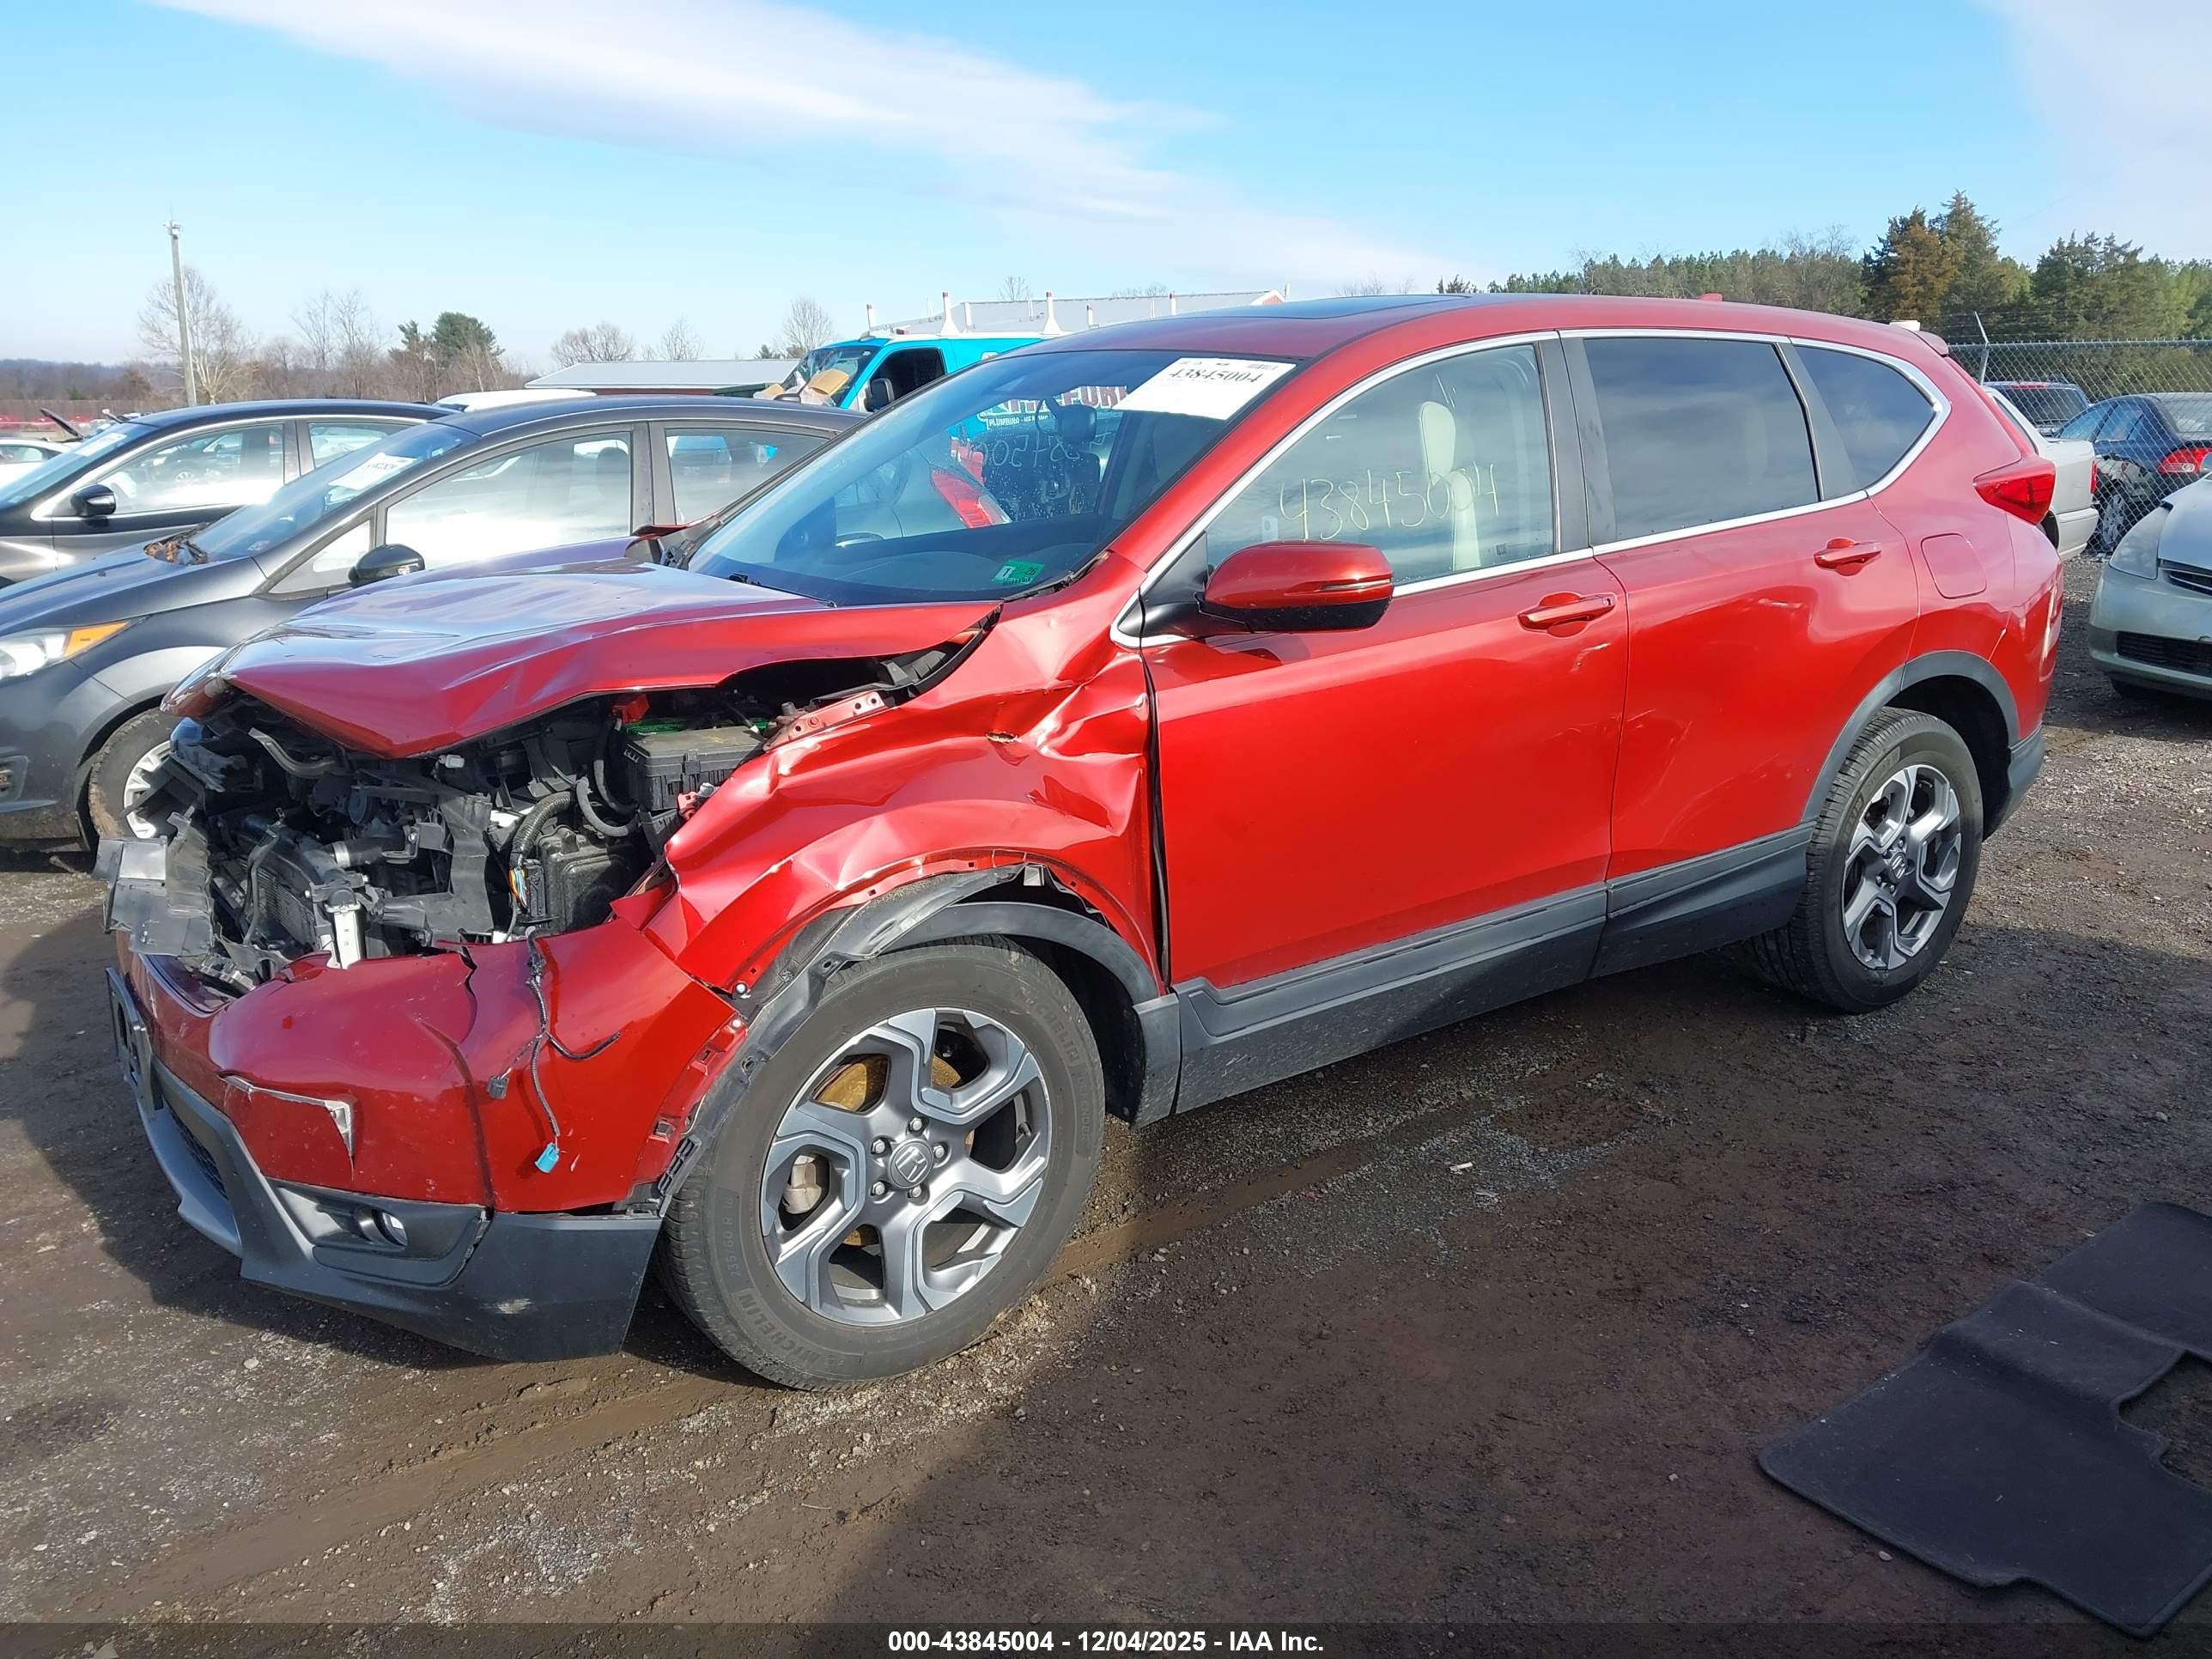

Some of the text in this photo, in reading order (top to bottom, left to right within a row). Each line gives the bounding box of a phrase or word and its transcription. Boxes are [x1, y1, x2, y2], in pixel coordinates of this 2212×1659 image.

[1169, 368, 1263, 383] 43845004
[1279, 461, 1499, 540] 43845004
[737, 1289, 822, 1368] MICHELIN
